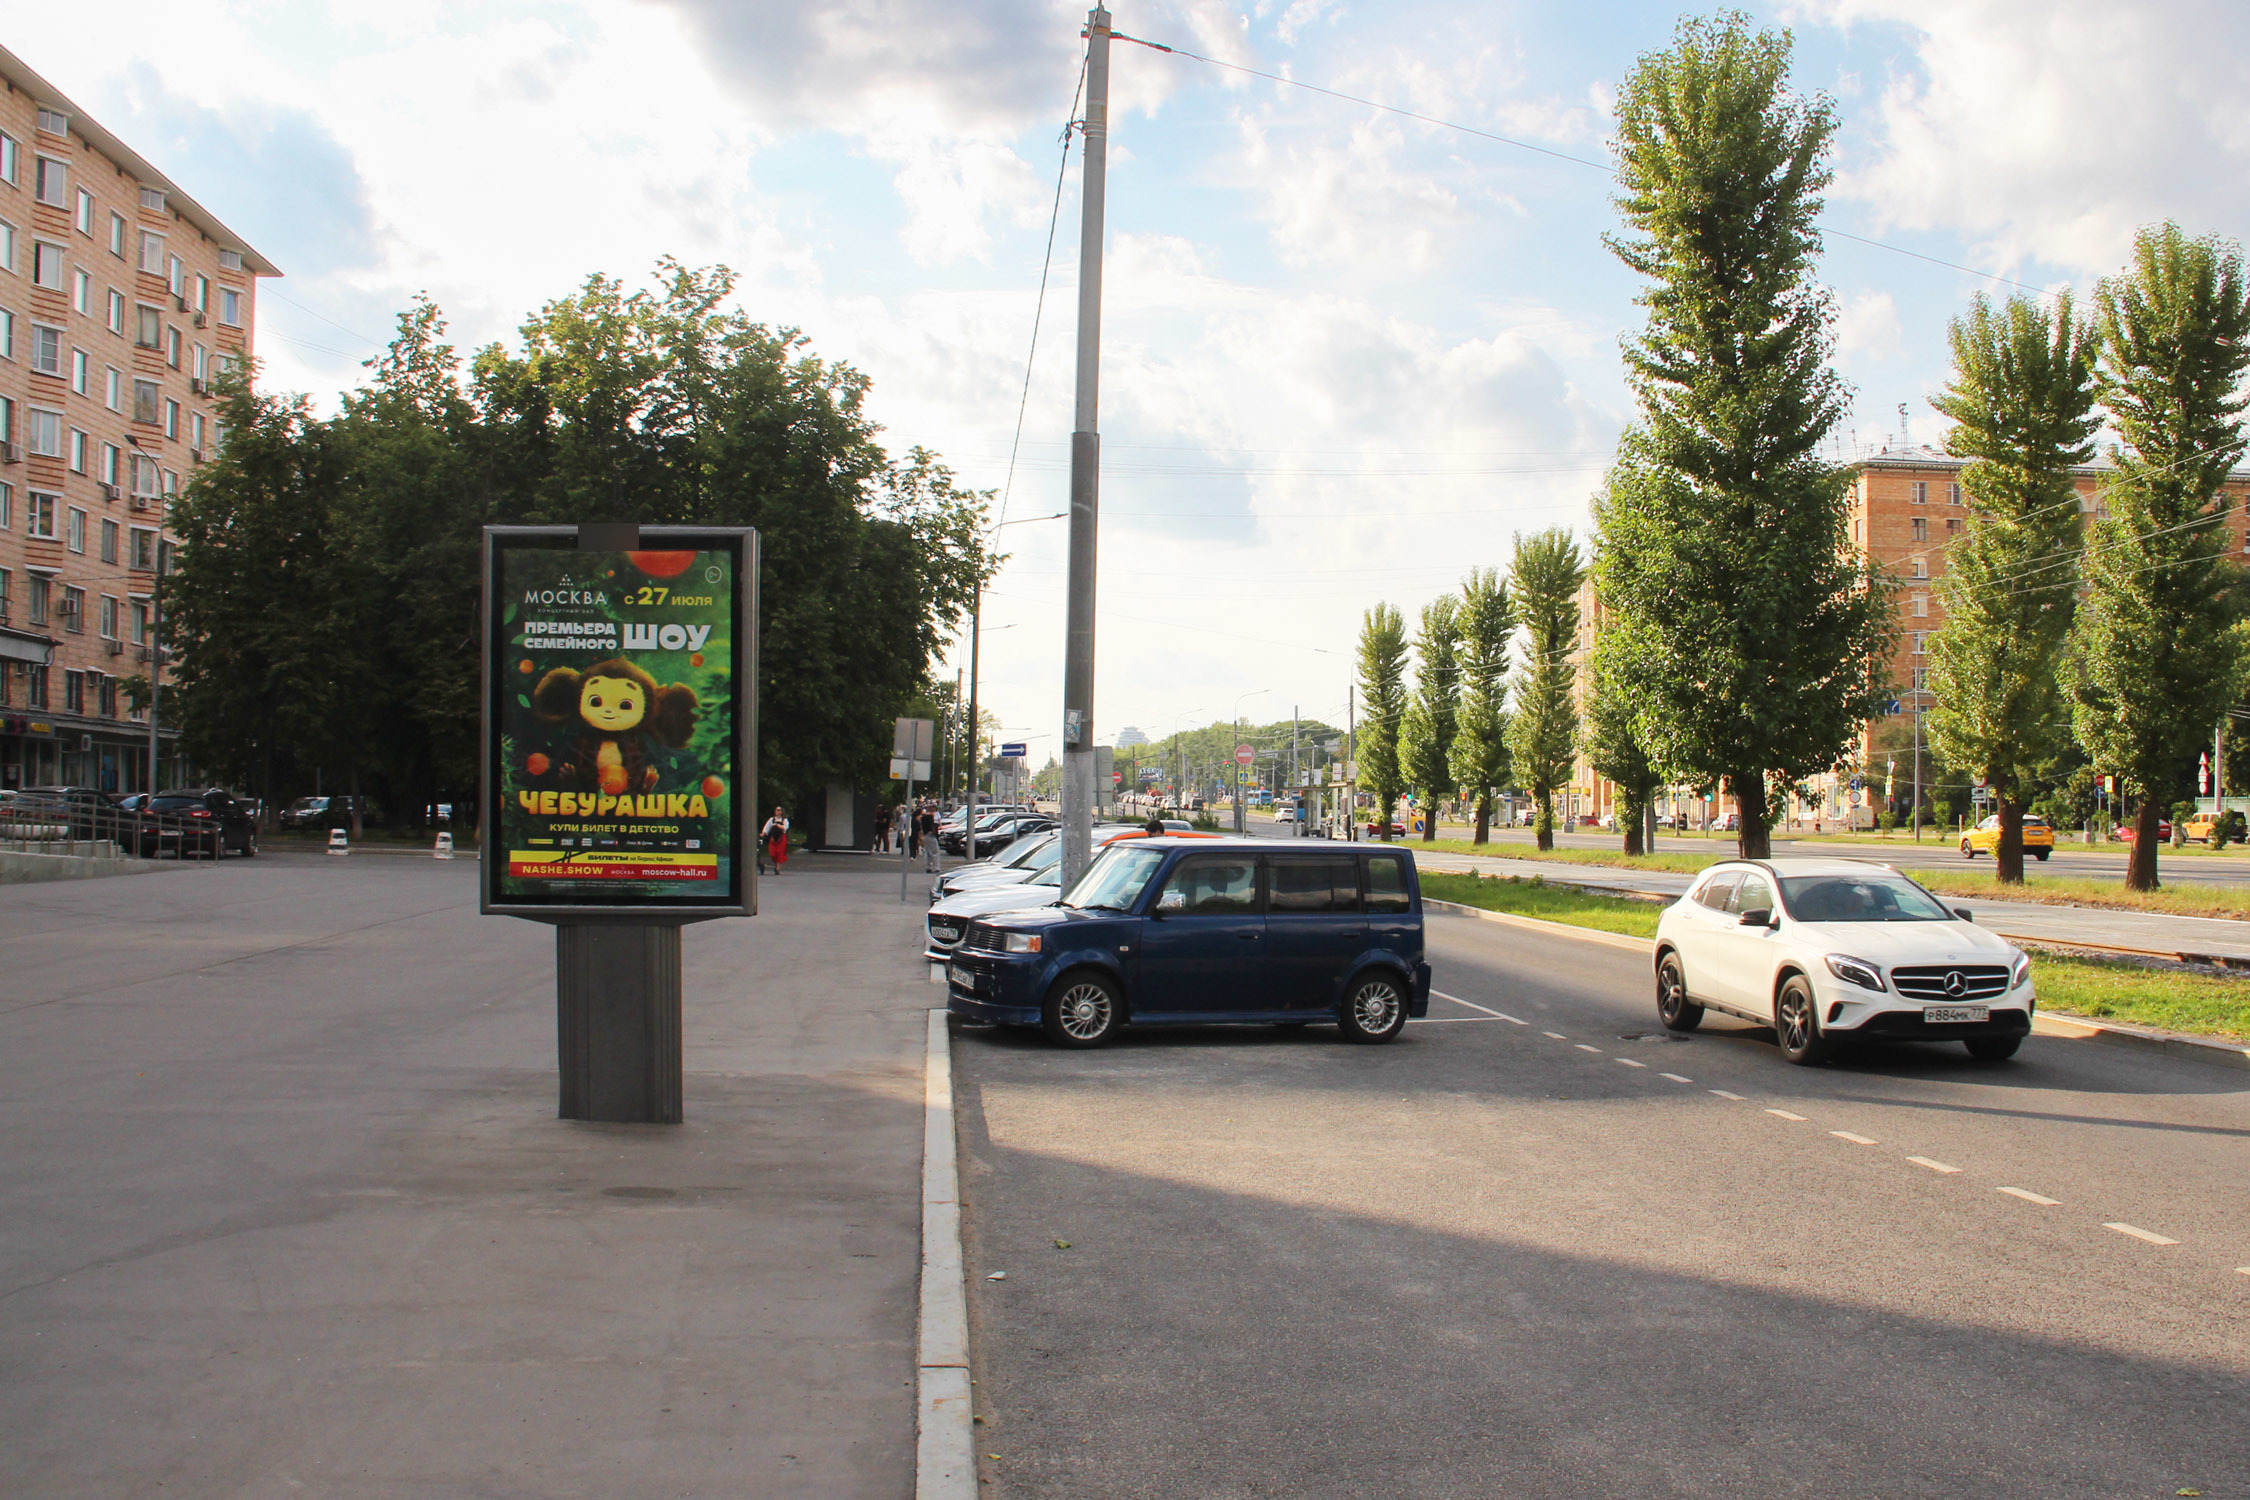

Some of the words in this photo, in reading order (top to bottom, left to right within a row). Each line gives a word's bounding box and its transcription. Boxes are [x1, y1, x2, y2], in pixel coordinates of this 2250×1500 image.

[524, 590, 607, 605] МОСКВА
[637, 586, 669, 605] 27
[524, 621, 616, 635] ПРЕМЬЕРА
[524, 636, 617, 650] СЕМЕЙНОГО
[623, 623, 712, 652] ШОУ
[519, 790, 709, 818] ЧЕБУРАШКА
[549, 823, 579, 832] КУПИ
[581, 824, 618, 832] БИЛЕТ
[619, 825, 627, 833] В
[628, 825, 679, 834] ДЕТСТВО
[522, 865, 604, 875] NASHE.SHOW
[642, 868, 707, 877] moscow-hall.ru
